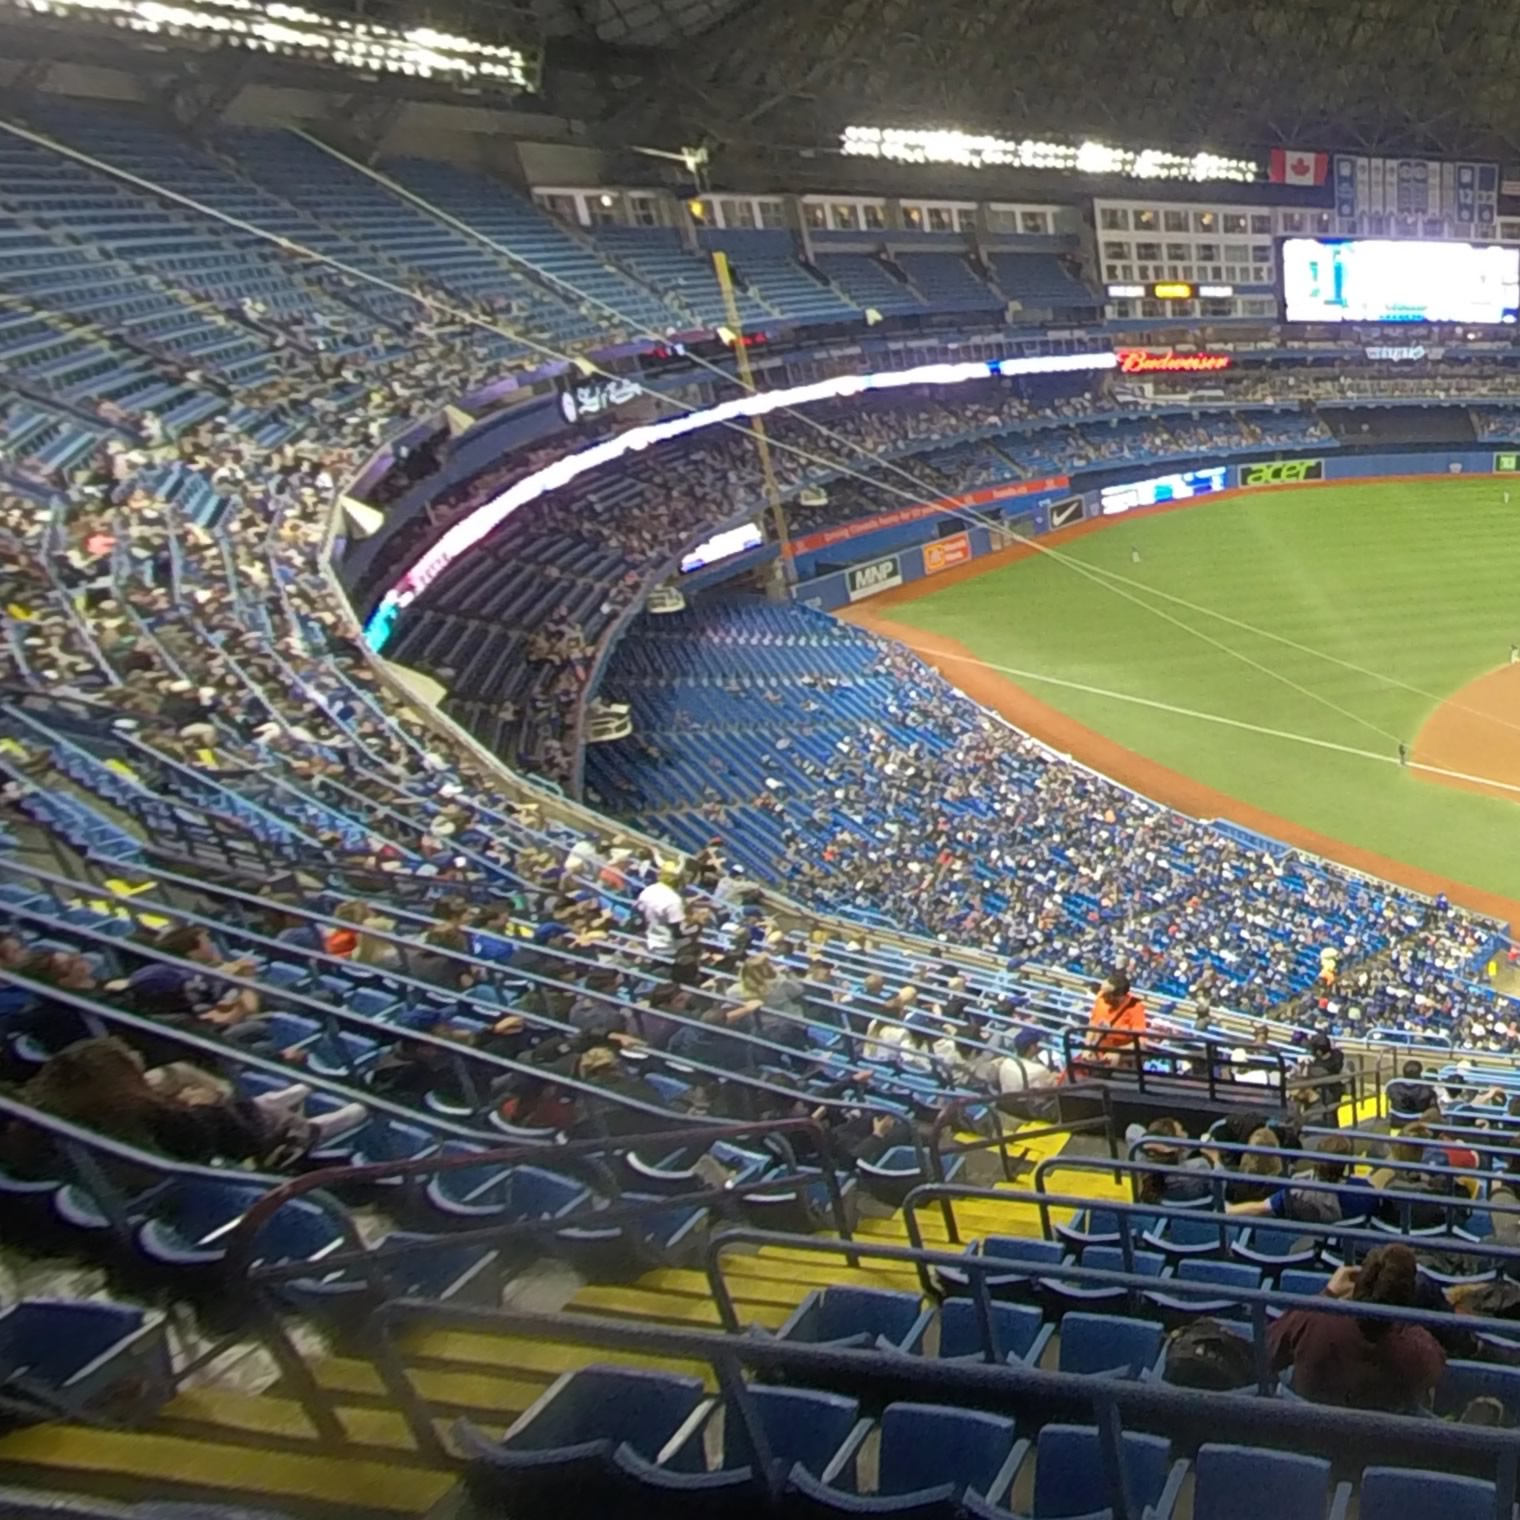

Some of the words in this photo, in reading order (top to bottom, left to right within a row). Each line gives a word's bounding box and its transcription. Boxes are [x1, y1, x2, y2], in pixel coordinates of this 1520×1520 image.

[1117, 348, 1230, 372] Budweiser
[1247, 461, 1315, 484] acer
[855, 561, 894, 590] MNP
